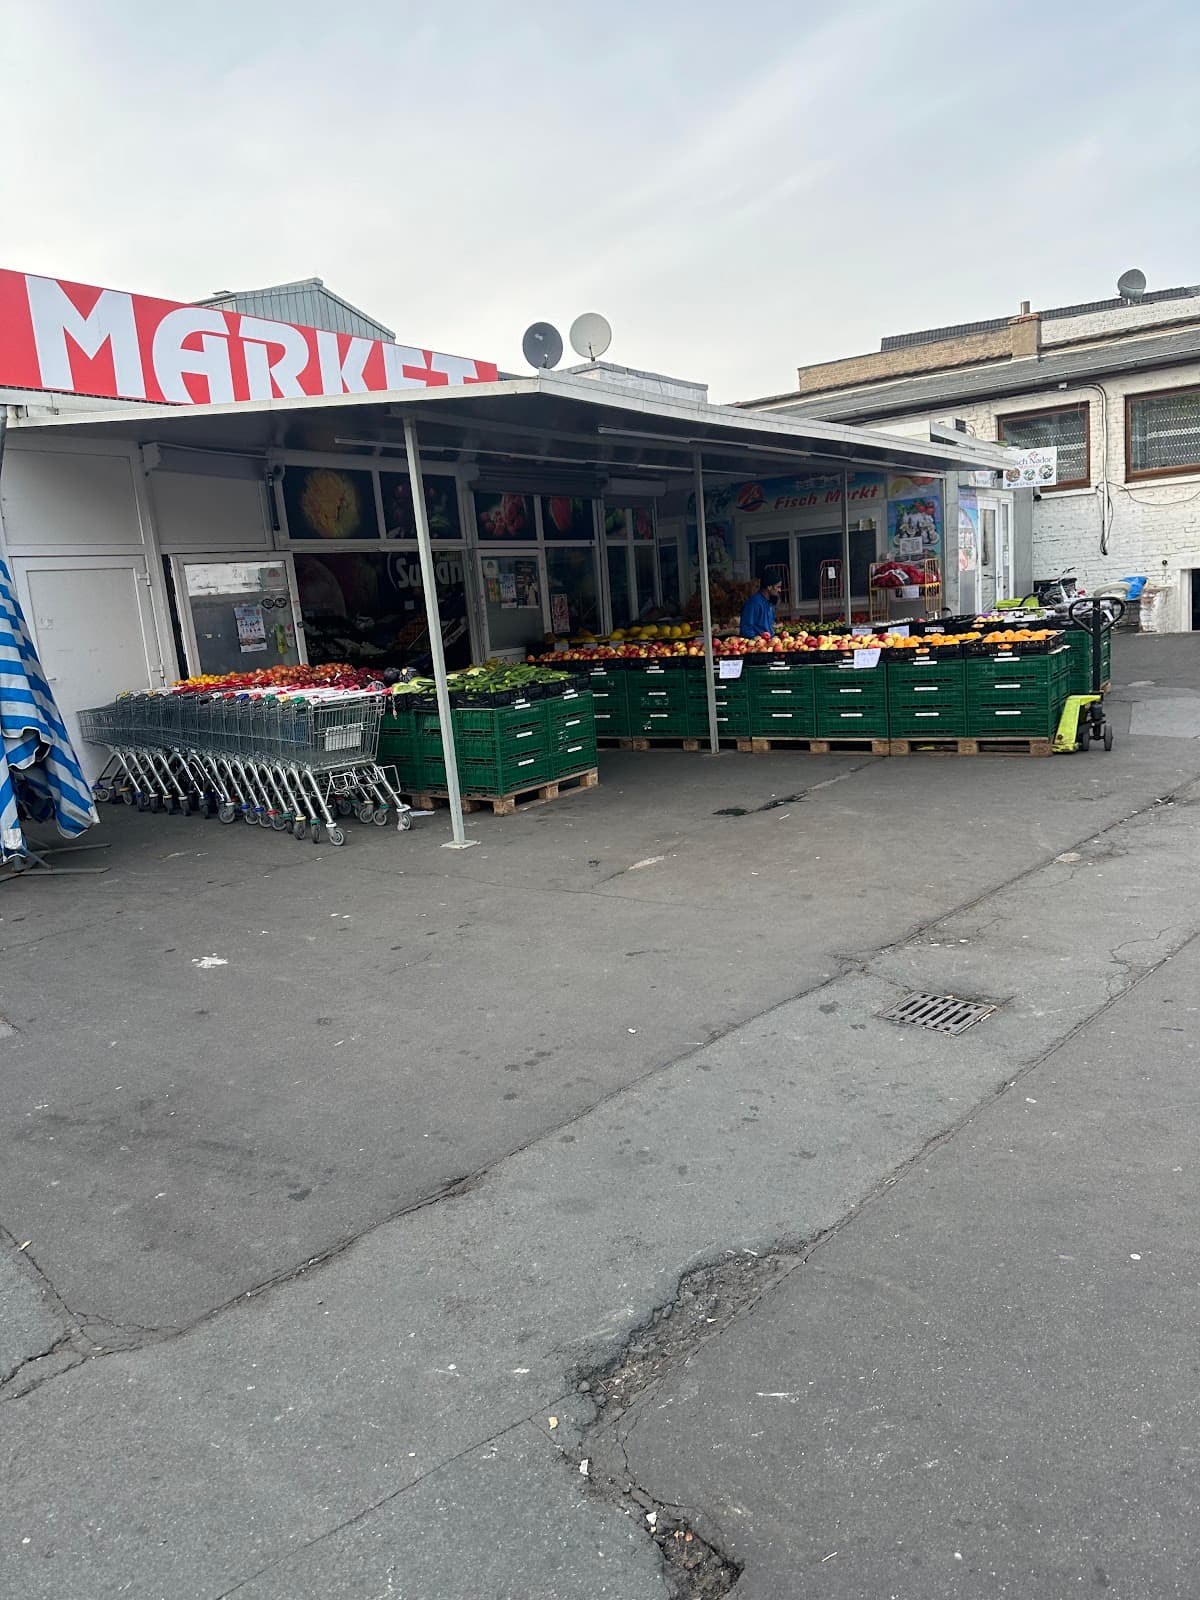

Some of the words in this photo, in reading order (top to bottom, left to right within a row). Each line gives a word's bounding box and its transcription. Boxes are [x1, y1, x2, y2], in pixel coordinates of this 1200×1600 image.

[774, 492, 817, 509] Fisch
[824, 485, 878, 503] Mrkt
[396, 558, 463, 588] Suan
